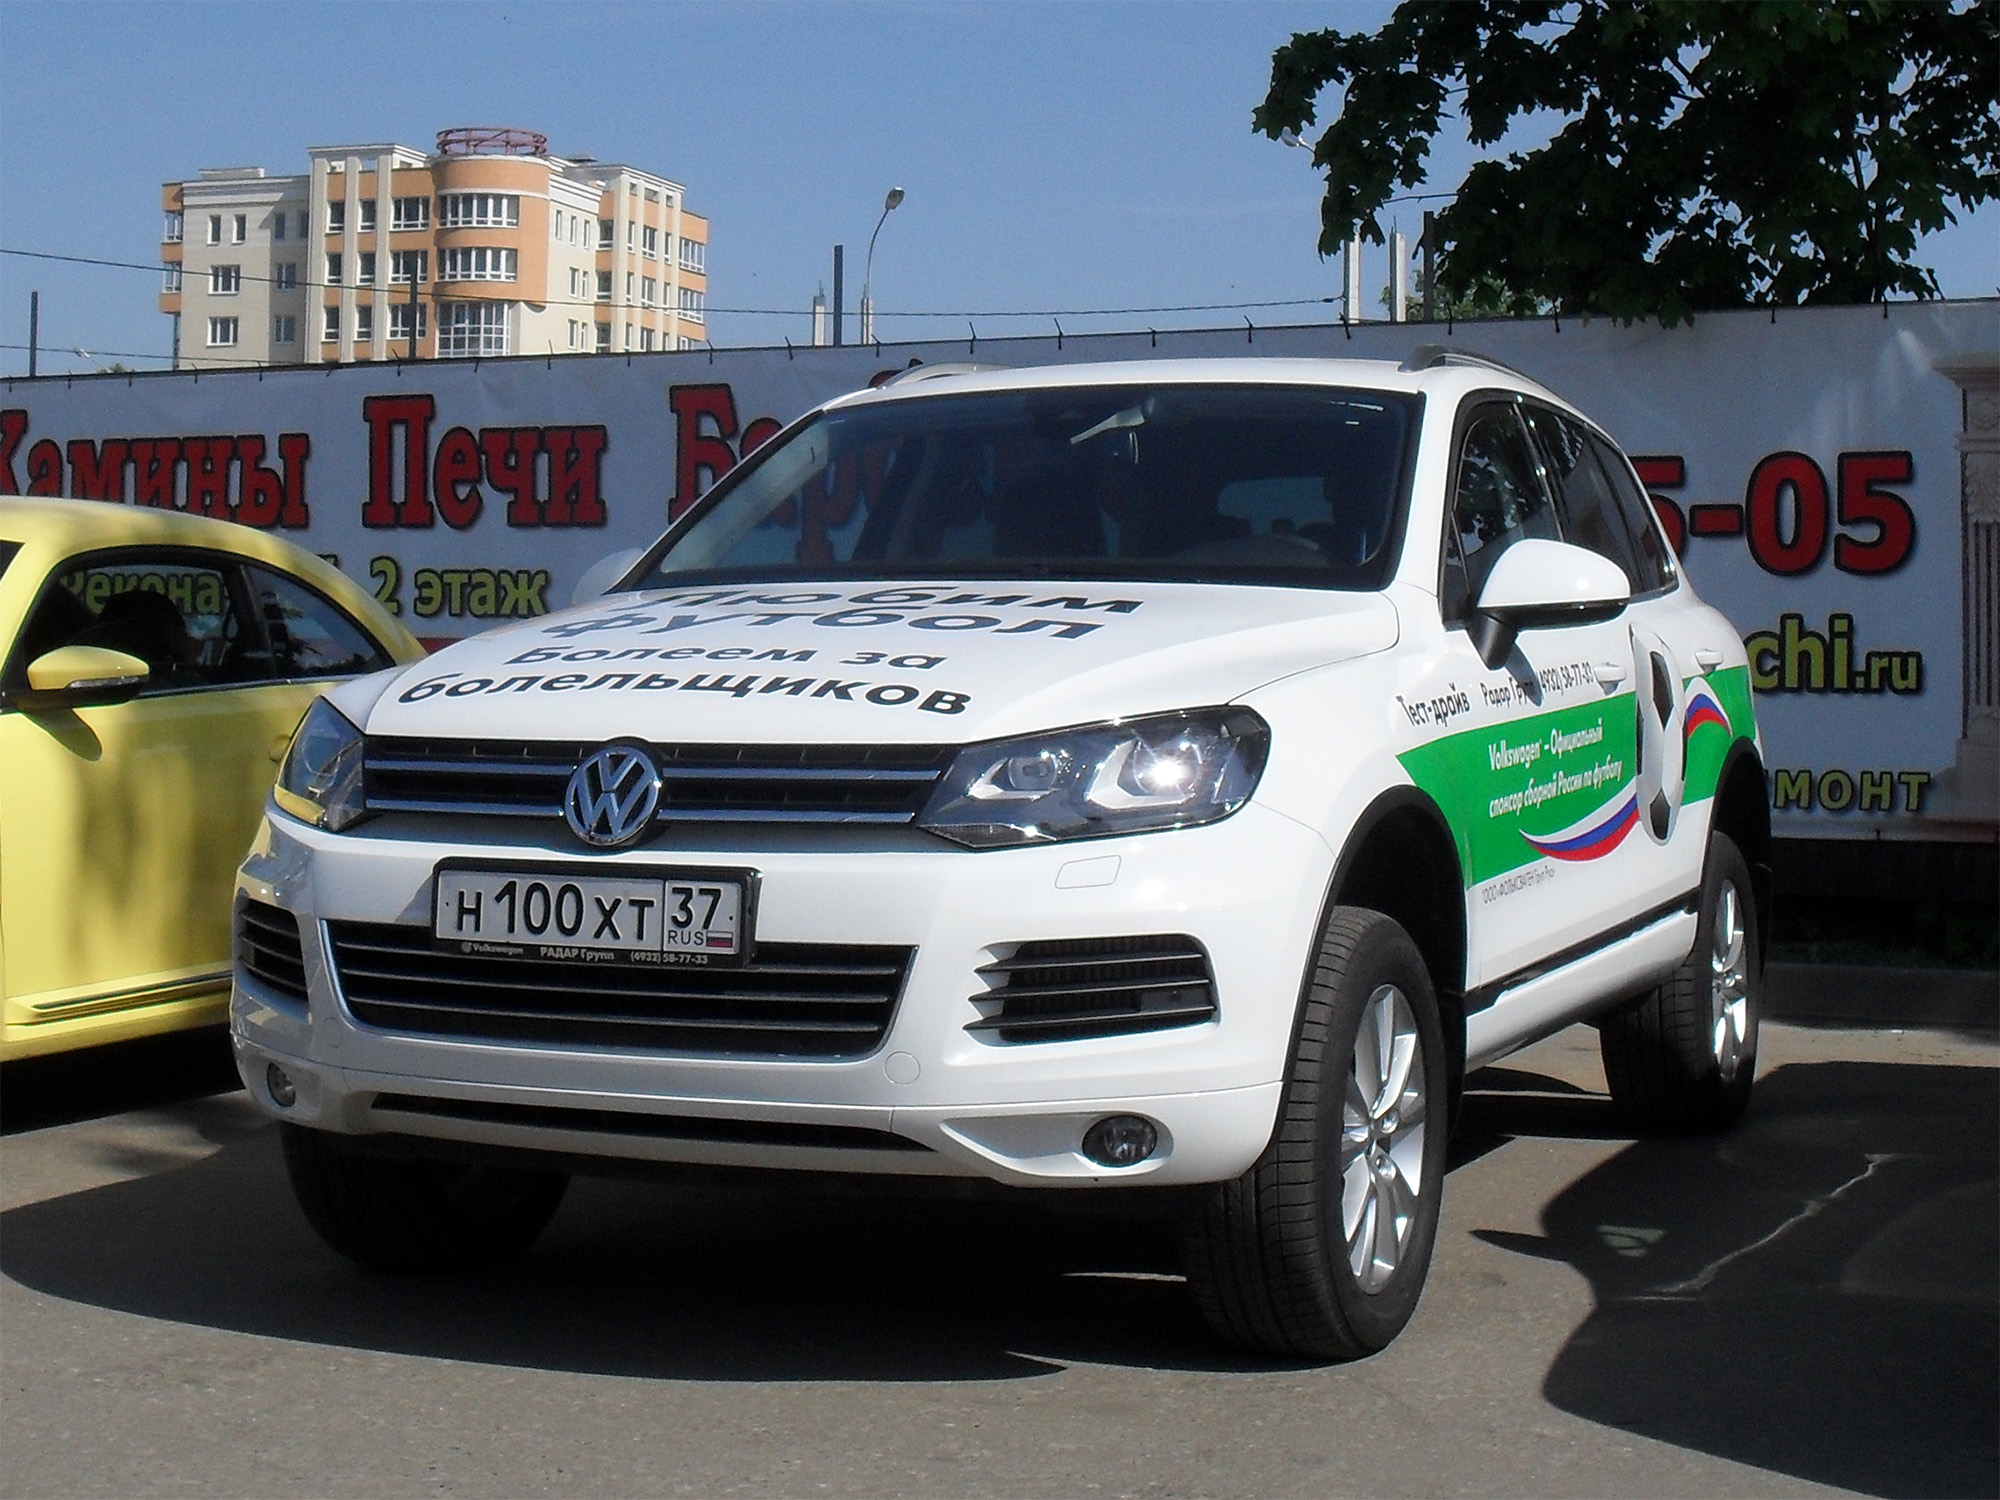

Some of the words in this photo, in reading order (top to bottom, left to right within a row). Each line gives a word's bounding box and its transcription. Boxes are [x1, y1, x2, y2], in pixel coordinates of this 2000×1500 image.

[362, 393, 608, 529] Печи
[370, 555, 401, 615] 2
[413, 567, 549, 618] этаж
[607, 586, 1144, 614] Любим
[503, 645, 818, 665] Болеем
[839, 651, 948, 670] за
[397, 672, 972, 715] болельщиков
[1764, 768, 1931, 812] МОНТ
[671, 887, 722, 930] 37
[540, 946, 580, 958] РАДАР
[580, 947, 615, 962] Групп
[667, 930, 705, 946] RUS
